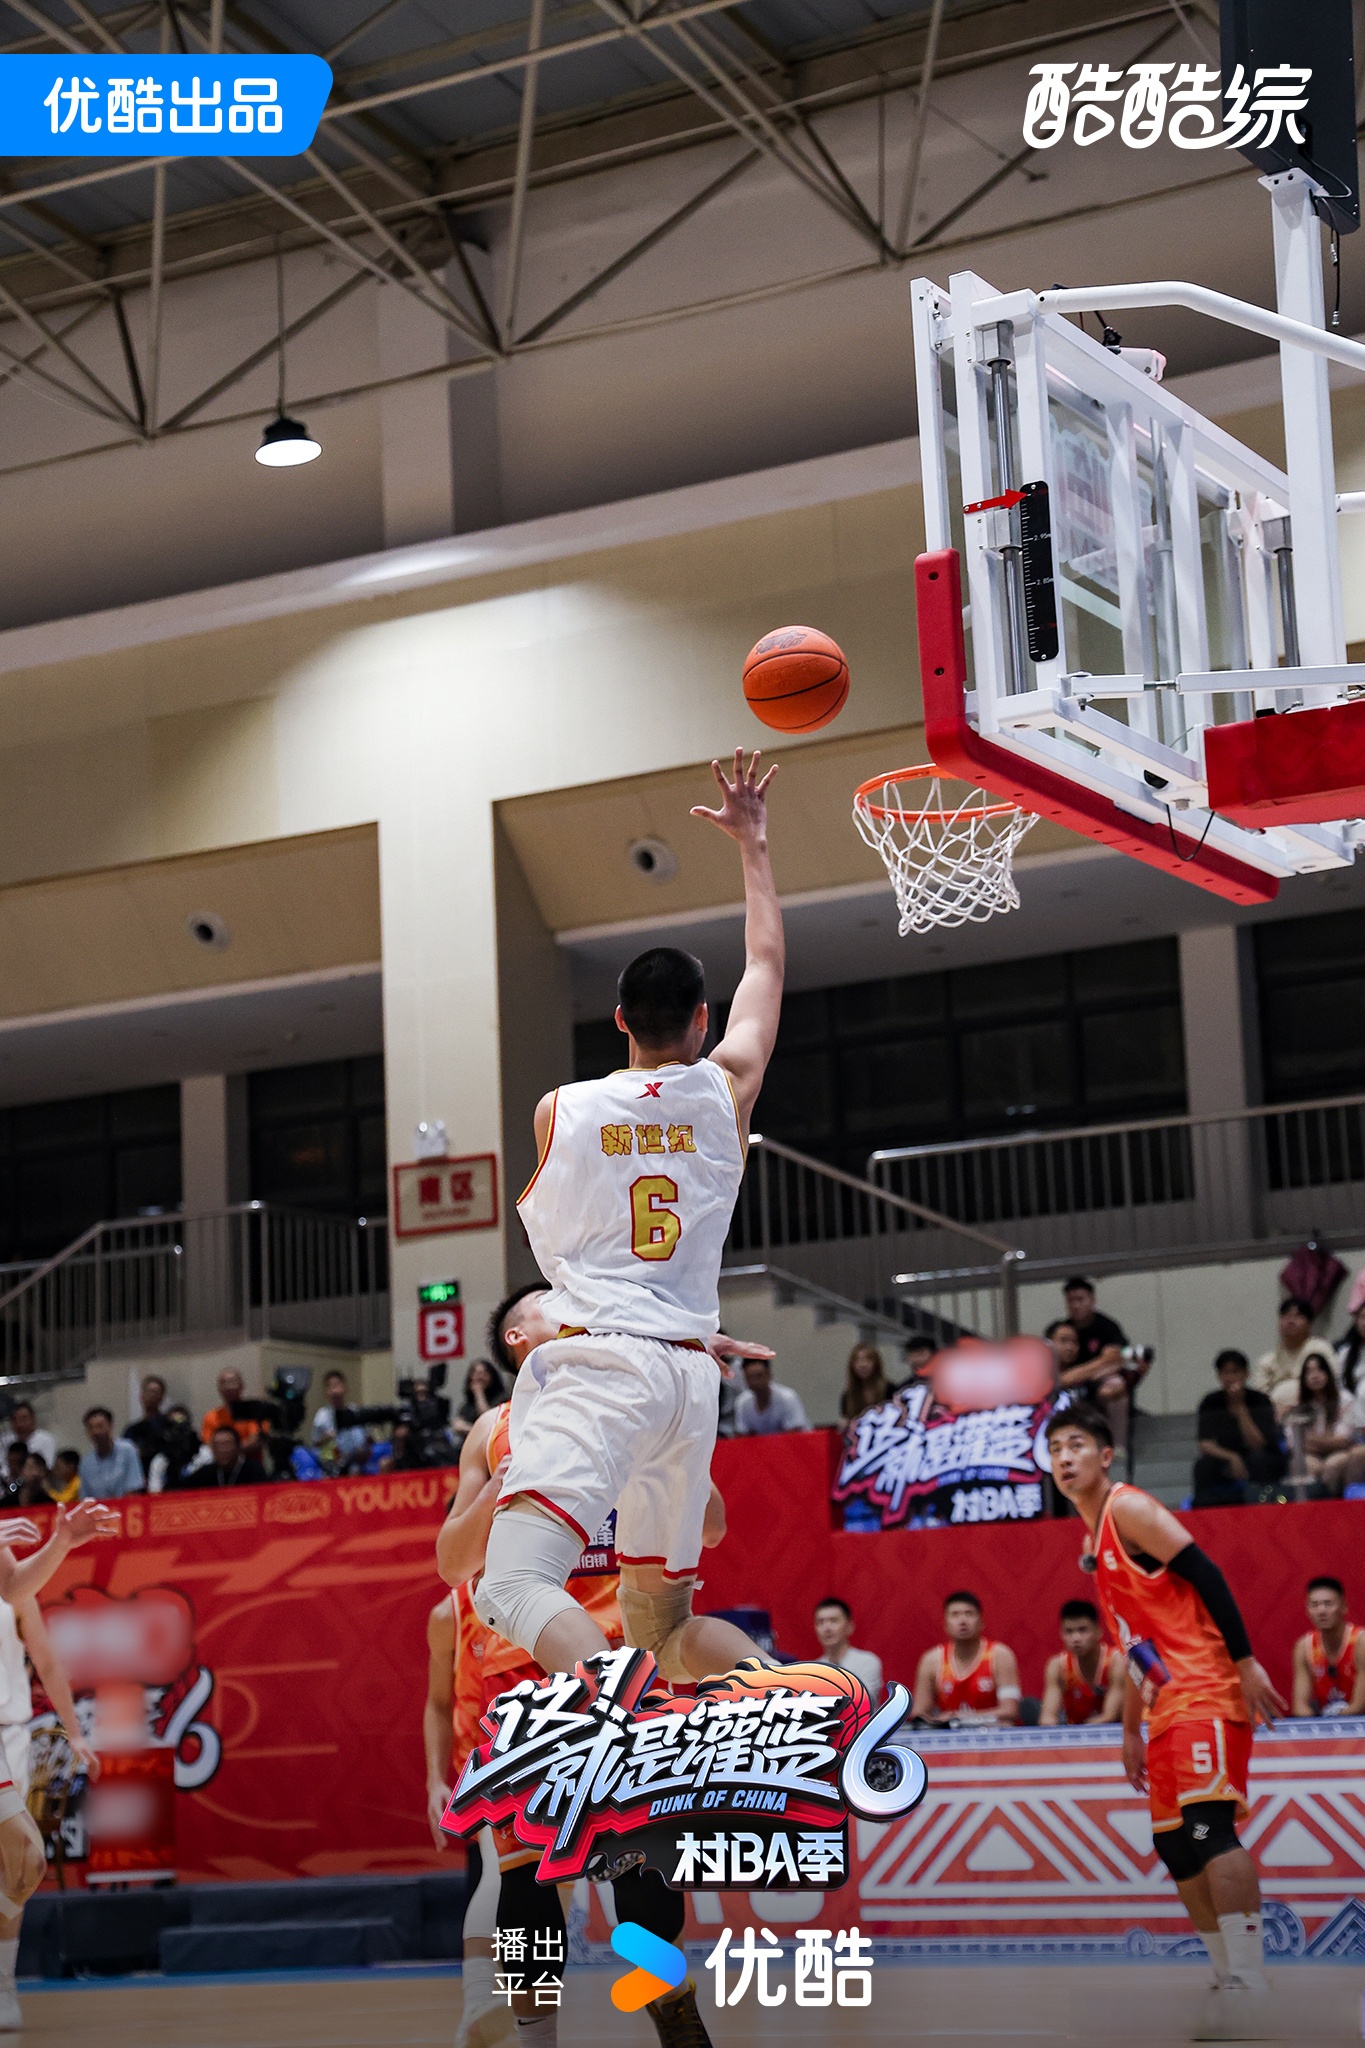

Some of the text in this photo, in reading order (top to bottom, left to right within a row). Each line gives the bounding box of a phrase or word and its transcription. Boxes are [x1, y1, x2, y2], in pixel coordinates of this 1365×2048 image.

[601, 1123, 698, 1156] 新世纪
[629, 1174, 682, 1262] 6
[425, 1310, 458, 1356] B
[337, 1480, 438, 1512] YOUKU
[950, 1483, 1043, 1523] 村BA季
[126, 1504, 144, 1538] 6
[1191, 1741, 1213, 1774] 5
